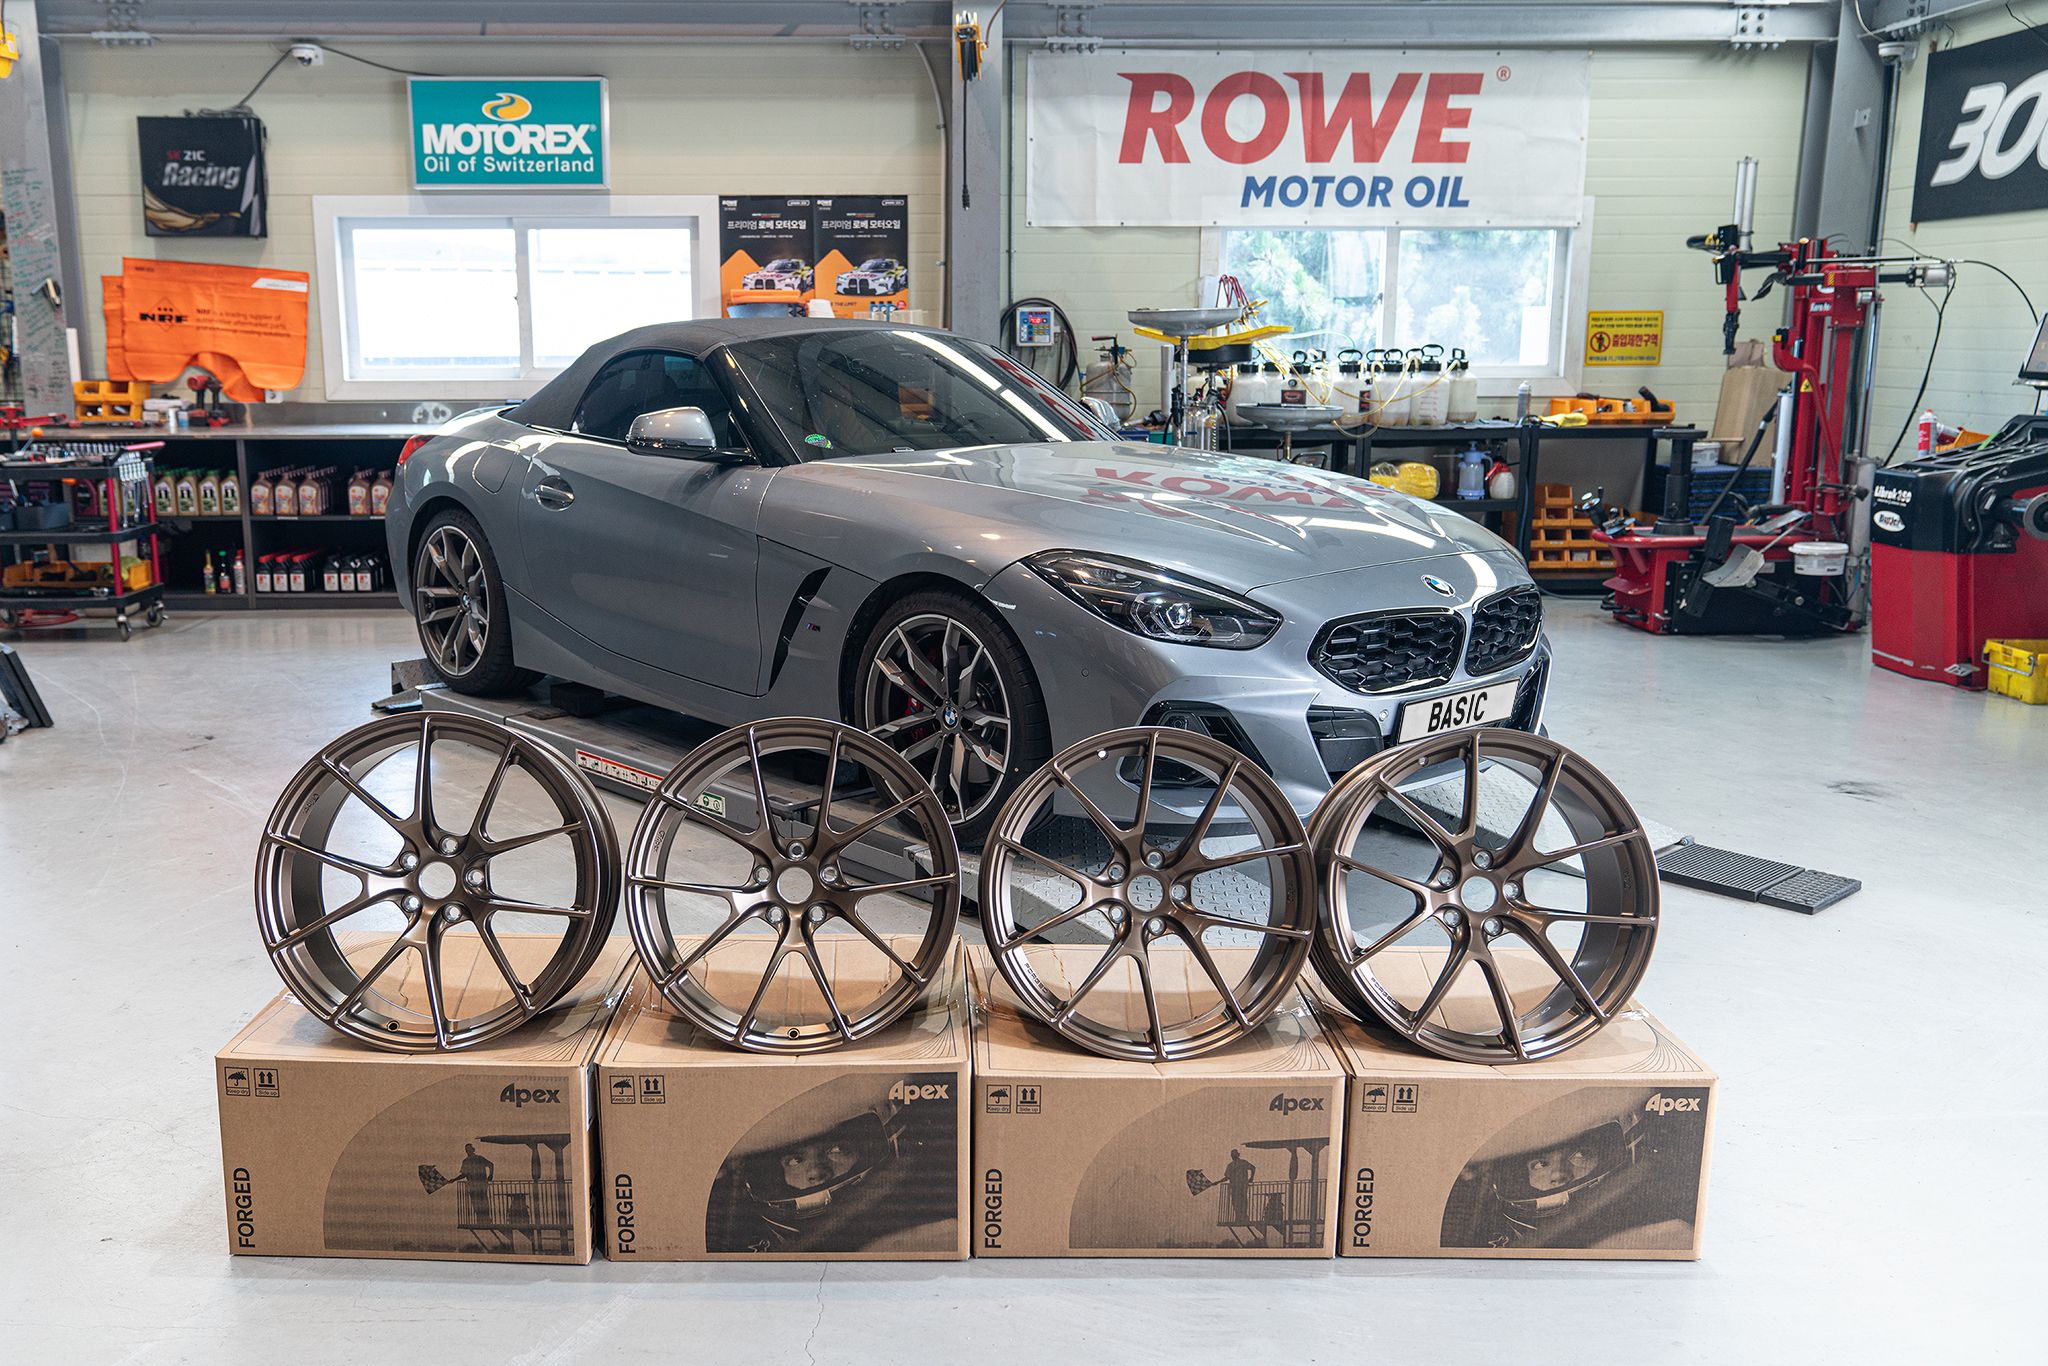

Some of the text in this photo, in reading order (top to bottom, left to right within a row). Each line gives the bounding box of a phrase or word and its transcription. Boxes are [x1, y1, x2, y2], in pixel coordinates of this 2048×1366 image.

[1116, 70, 1485, 165] ROWE
[1930, 68, 2048, 187] 30
[183, 150, 206, 161] ZIC
[424, 156, 595, 173] Oil of Switzerland
[162, 162, 241, 190] Racing
[1241, 175, 1471, 209] MOTOR OIL
[775, 220, 807, 230] 모터오일
[869, 220, 901, 230] 모터오일
[139, 312, 188, 324] NRF
[1427, 691, 1488, 733] BASIC
[500, 1082, 561, 1108] Apex
[888, 1080, 949, 1105] Apex
[1269, 1093, 1324, 1116] Apex
[1645, 1092, 1701, 1116] Apex
[232, 1167, 256, 1248] FORGED
[615, 1173, 636, 1254] FORGED
[984, 1168, 1003, 1249] FORGED
[1353, 1167, 1375, 1248] FORGED
